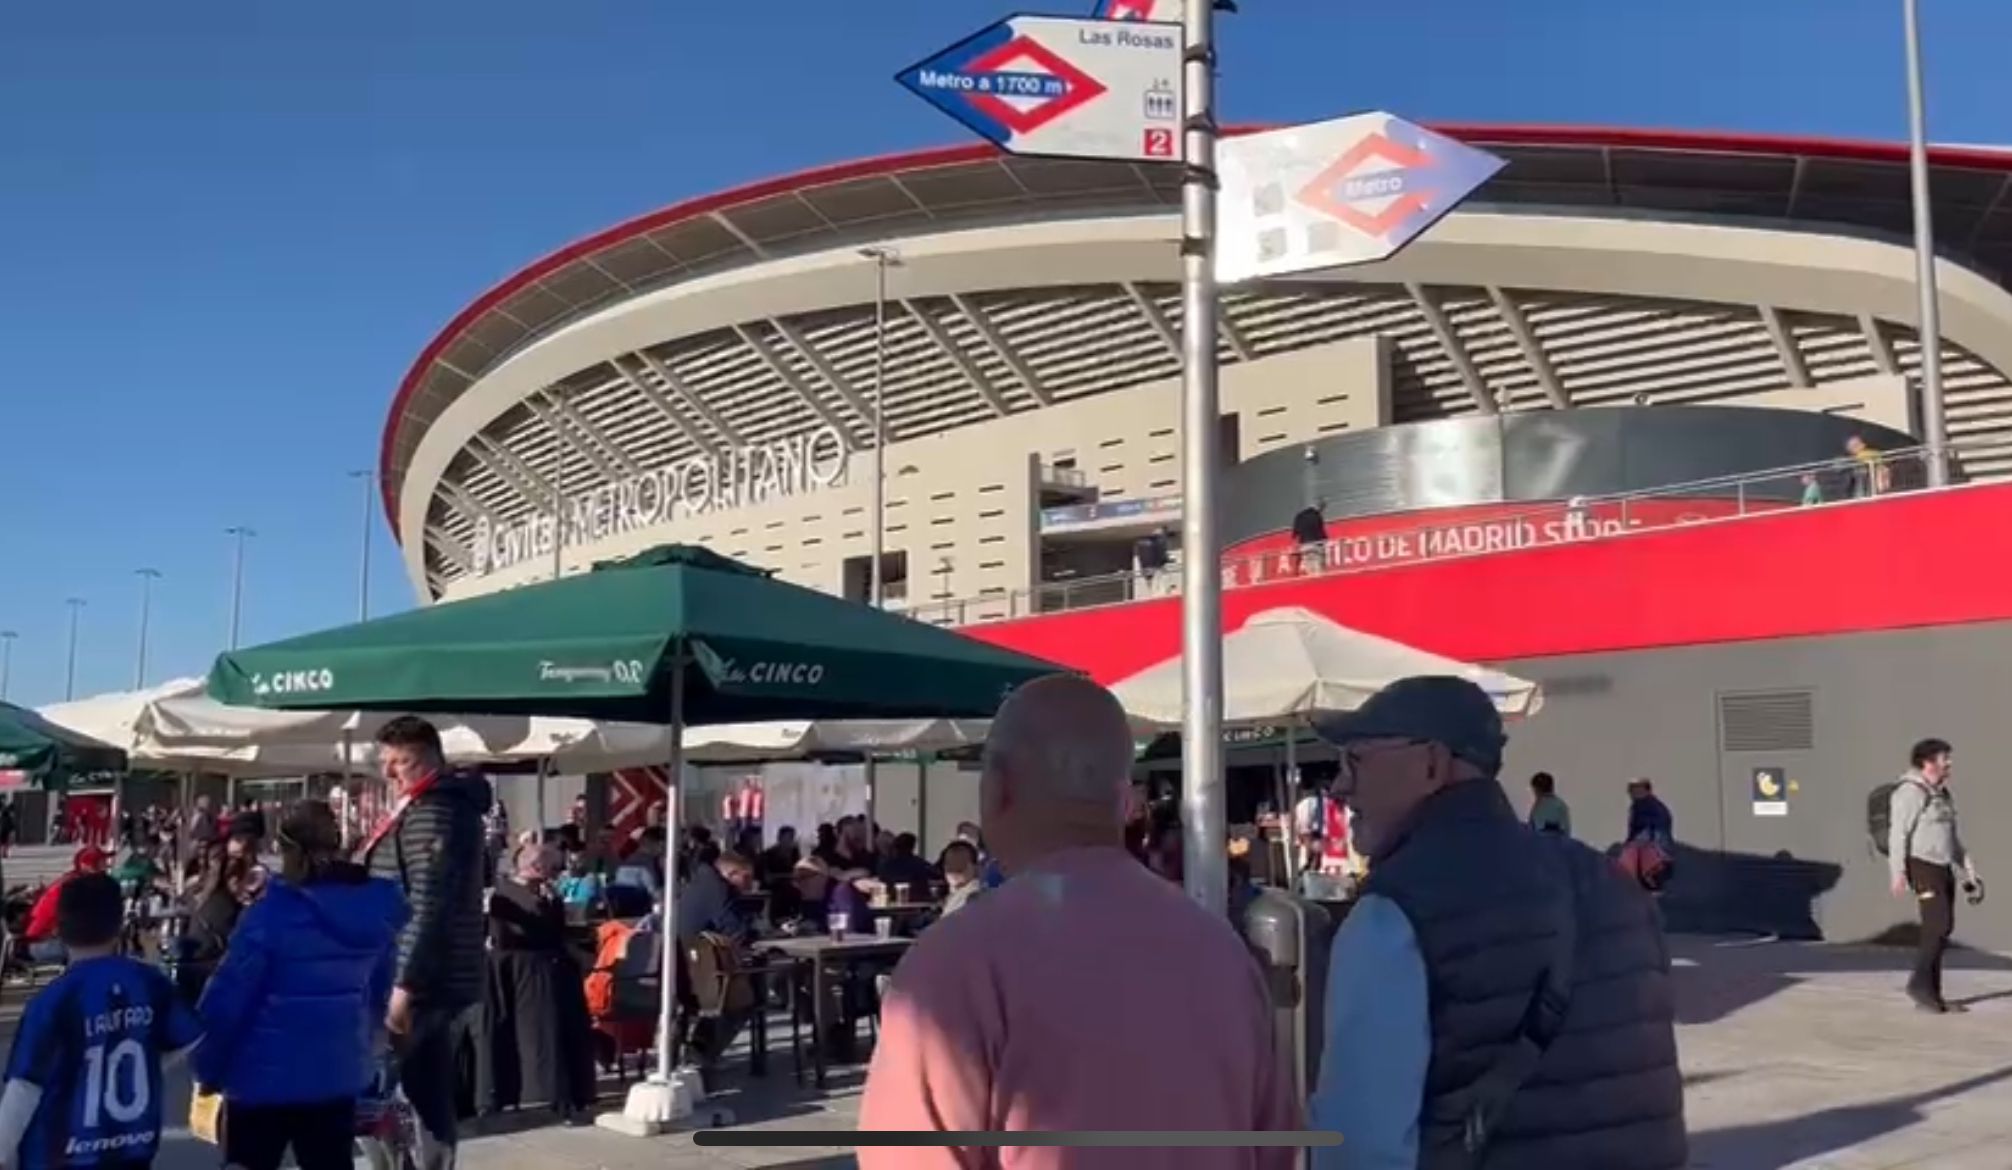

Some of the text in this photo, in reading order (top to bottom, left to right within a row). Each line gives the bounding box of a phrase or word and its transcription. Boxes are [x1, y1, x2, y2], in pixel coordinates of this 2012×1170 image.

[1079, 28, 1175, 49] Las Rosas
[919, 71, 974, 89] Metro
[978, 76, 991, 91] a
[996, 77, 1041, 94] 1700
[1150, 130, 1168, 154] 2
[1344, 176, 1402, 196] Metro
[1377, 535, 1413, 559] DE
[1419, 520, 1536, 557] MADRID
[749, 661, 823, 684] CINCO
[82, 1038, 149, 1127] 10
